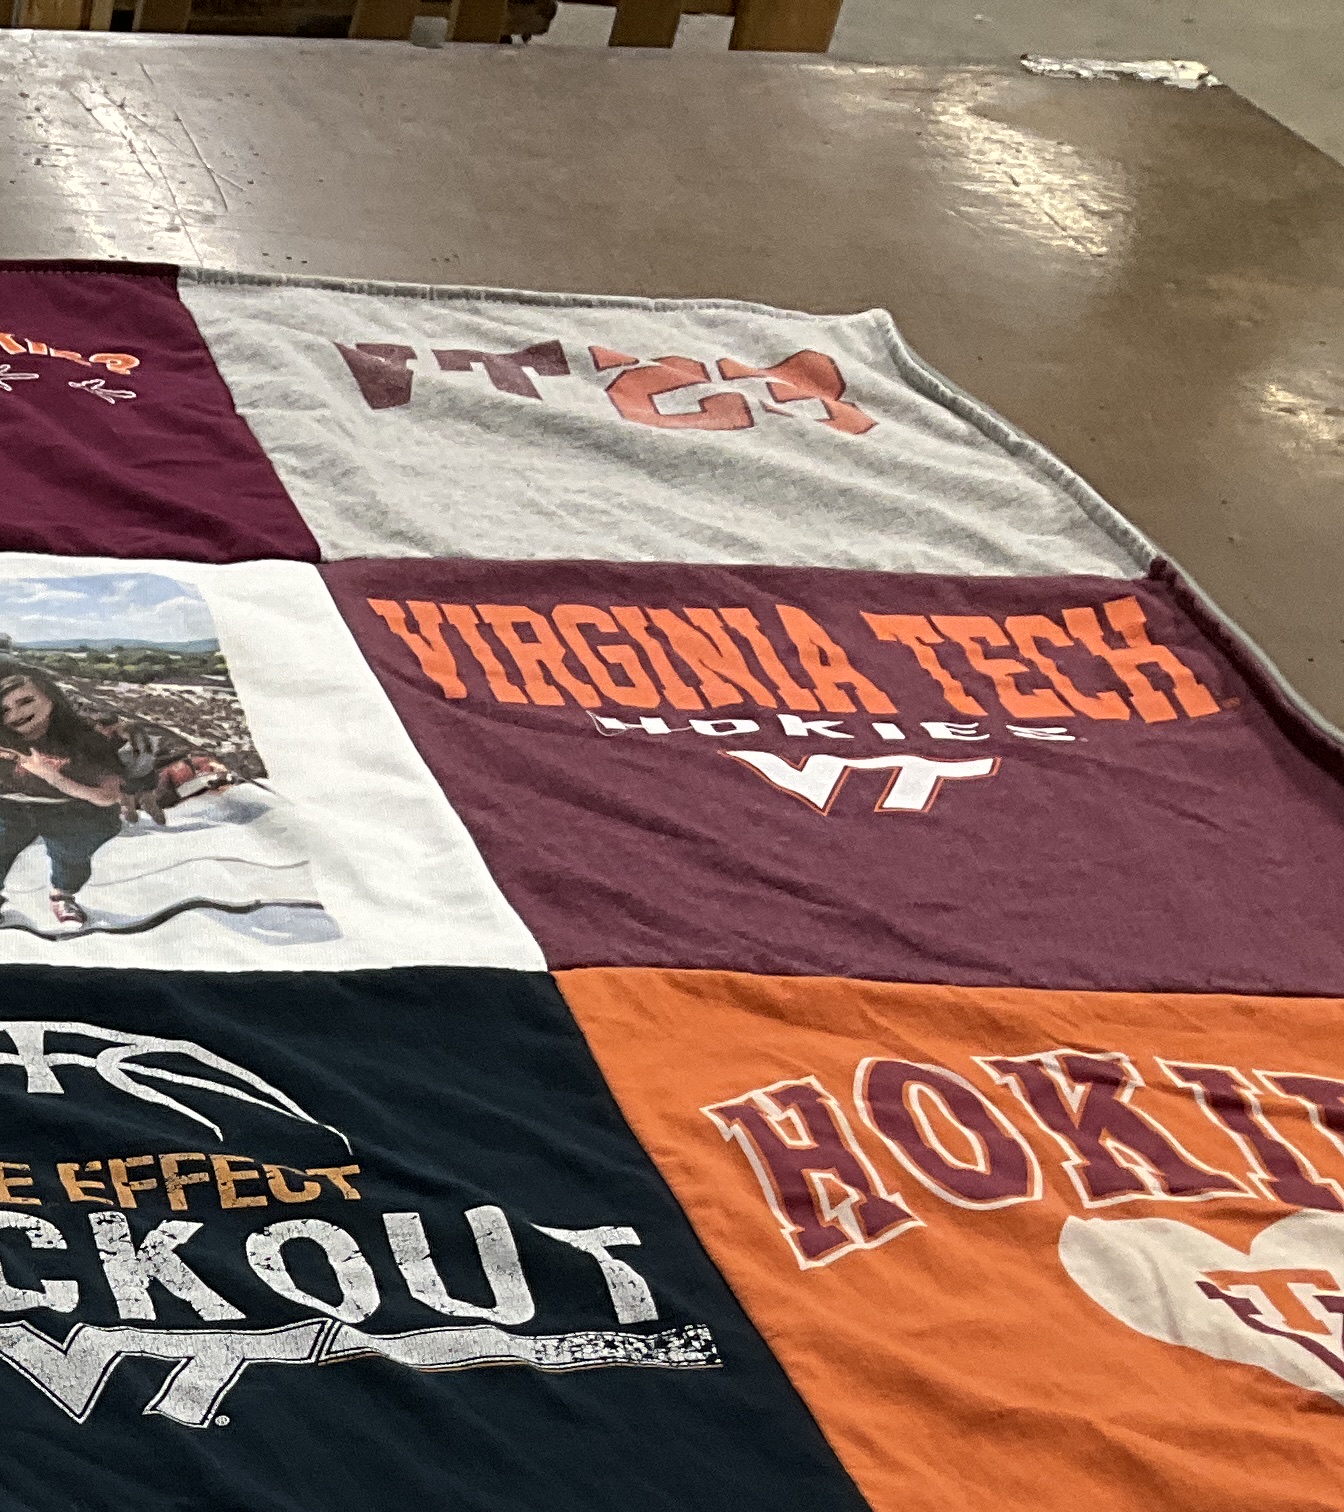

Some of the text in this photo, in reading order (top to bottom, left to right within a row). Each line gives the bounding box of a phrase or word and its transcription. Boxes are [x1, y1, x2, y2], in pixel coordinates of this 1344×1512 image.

[367, 595, 1221, 724] VIRGINIA TECH
[587, 709, 1076, 743] HOKIES
[717, 748, 1003, 817] VT
[57, 1152, 363, 1212] EFFECT
